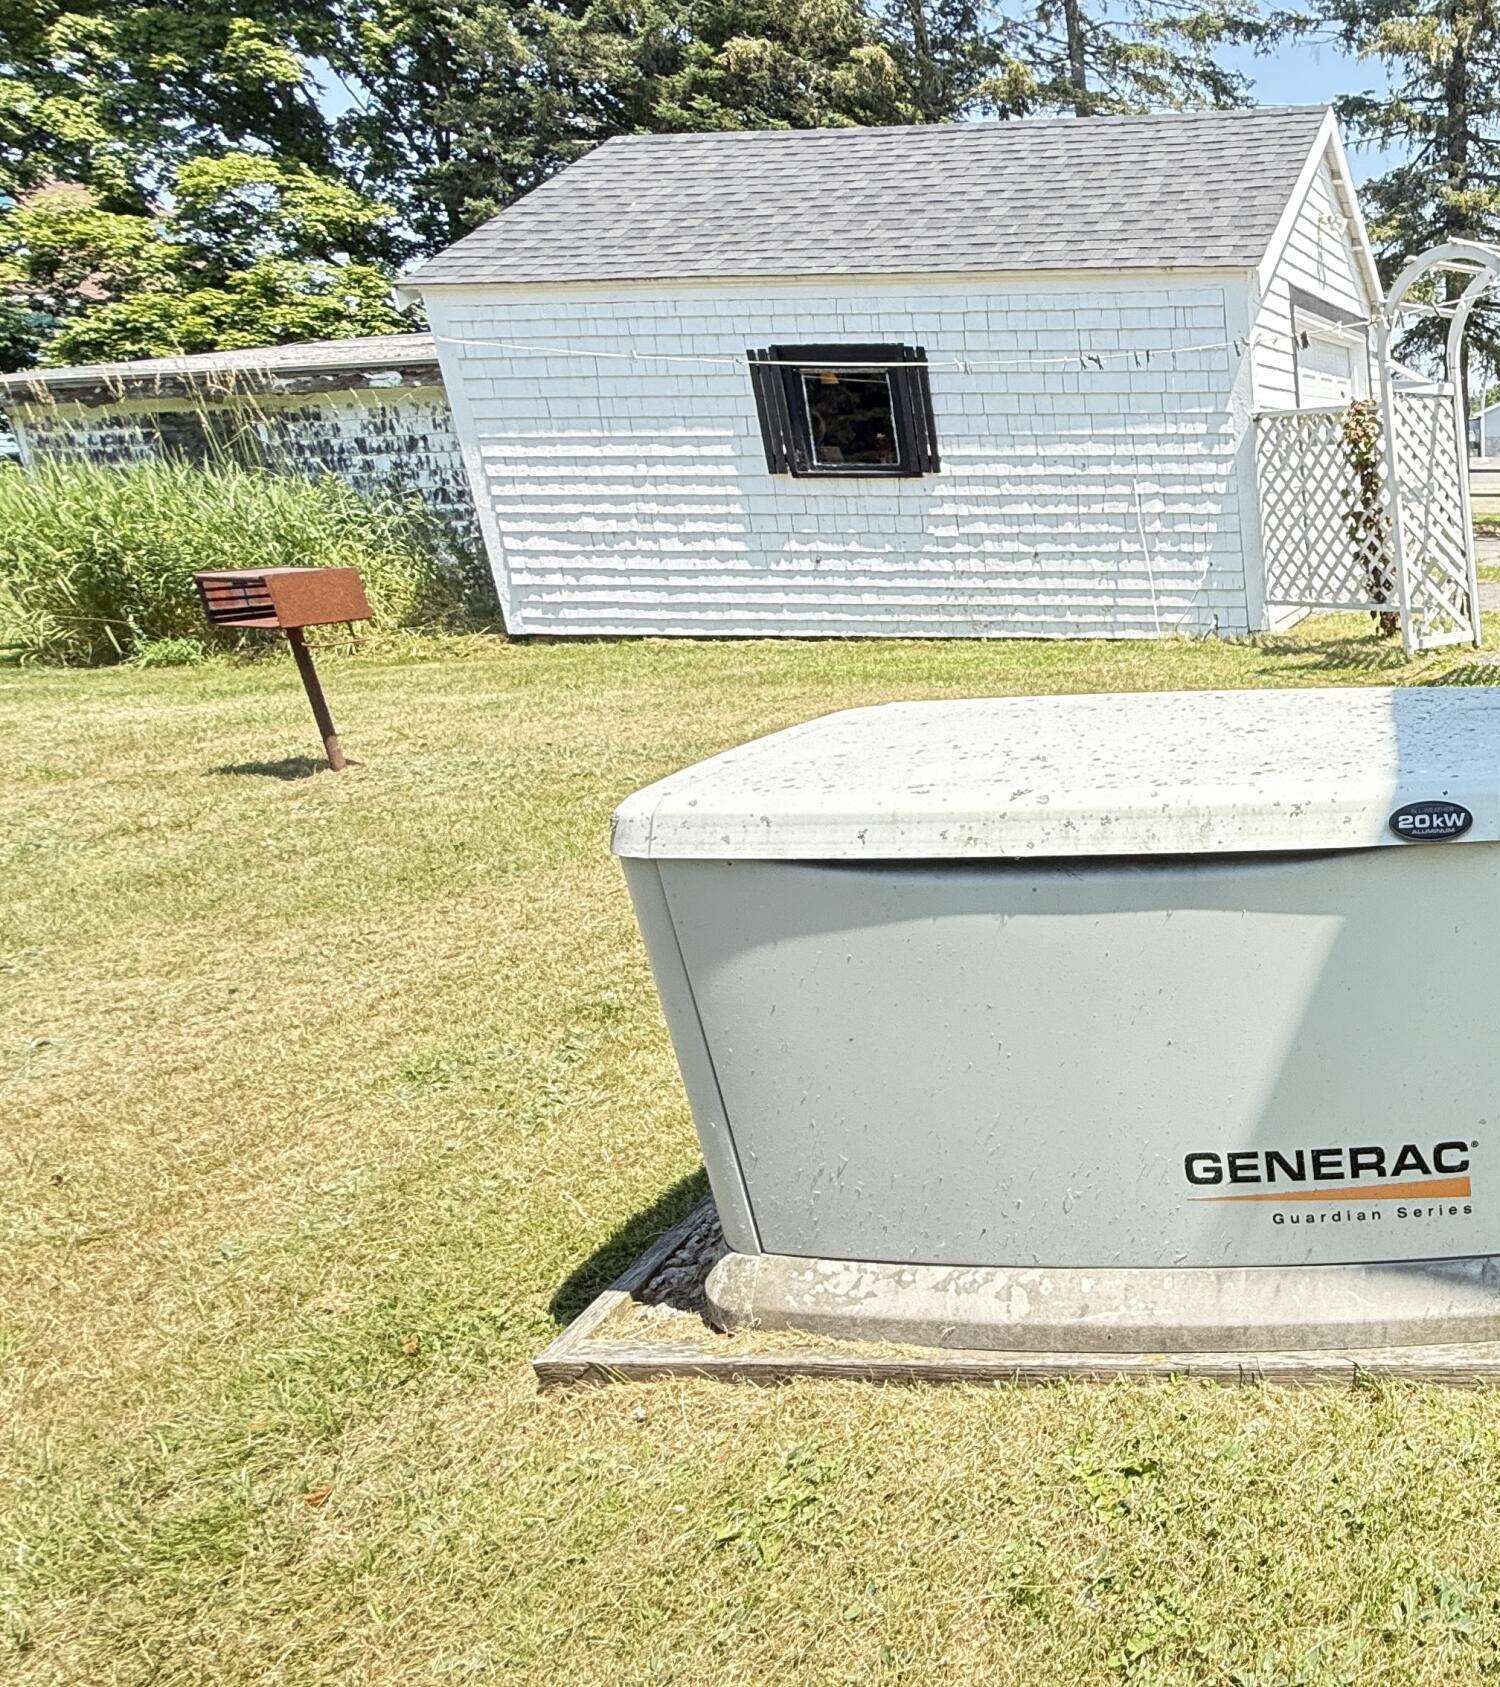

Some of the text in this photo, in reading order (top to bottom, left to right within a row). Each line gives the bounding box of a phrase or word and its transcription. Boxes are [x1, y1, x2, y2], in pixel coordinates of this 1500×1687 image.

[1412, 827, 1456, 835] ALUMINUM
[1273, 1203, 1473, 1225] Guardian Series
